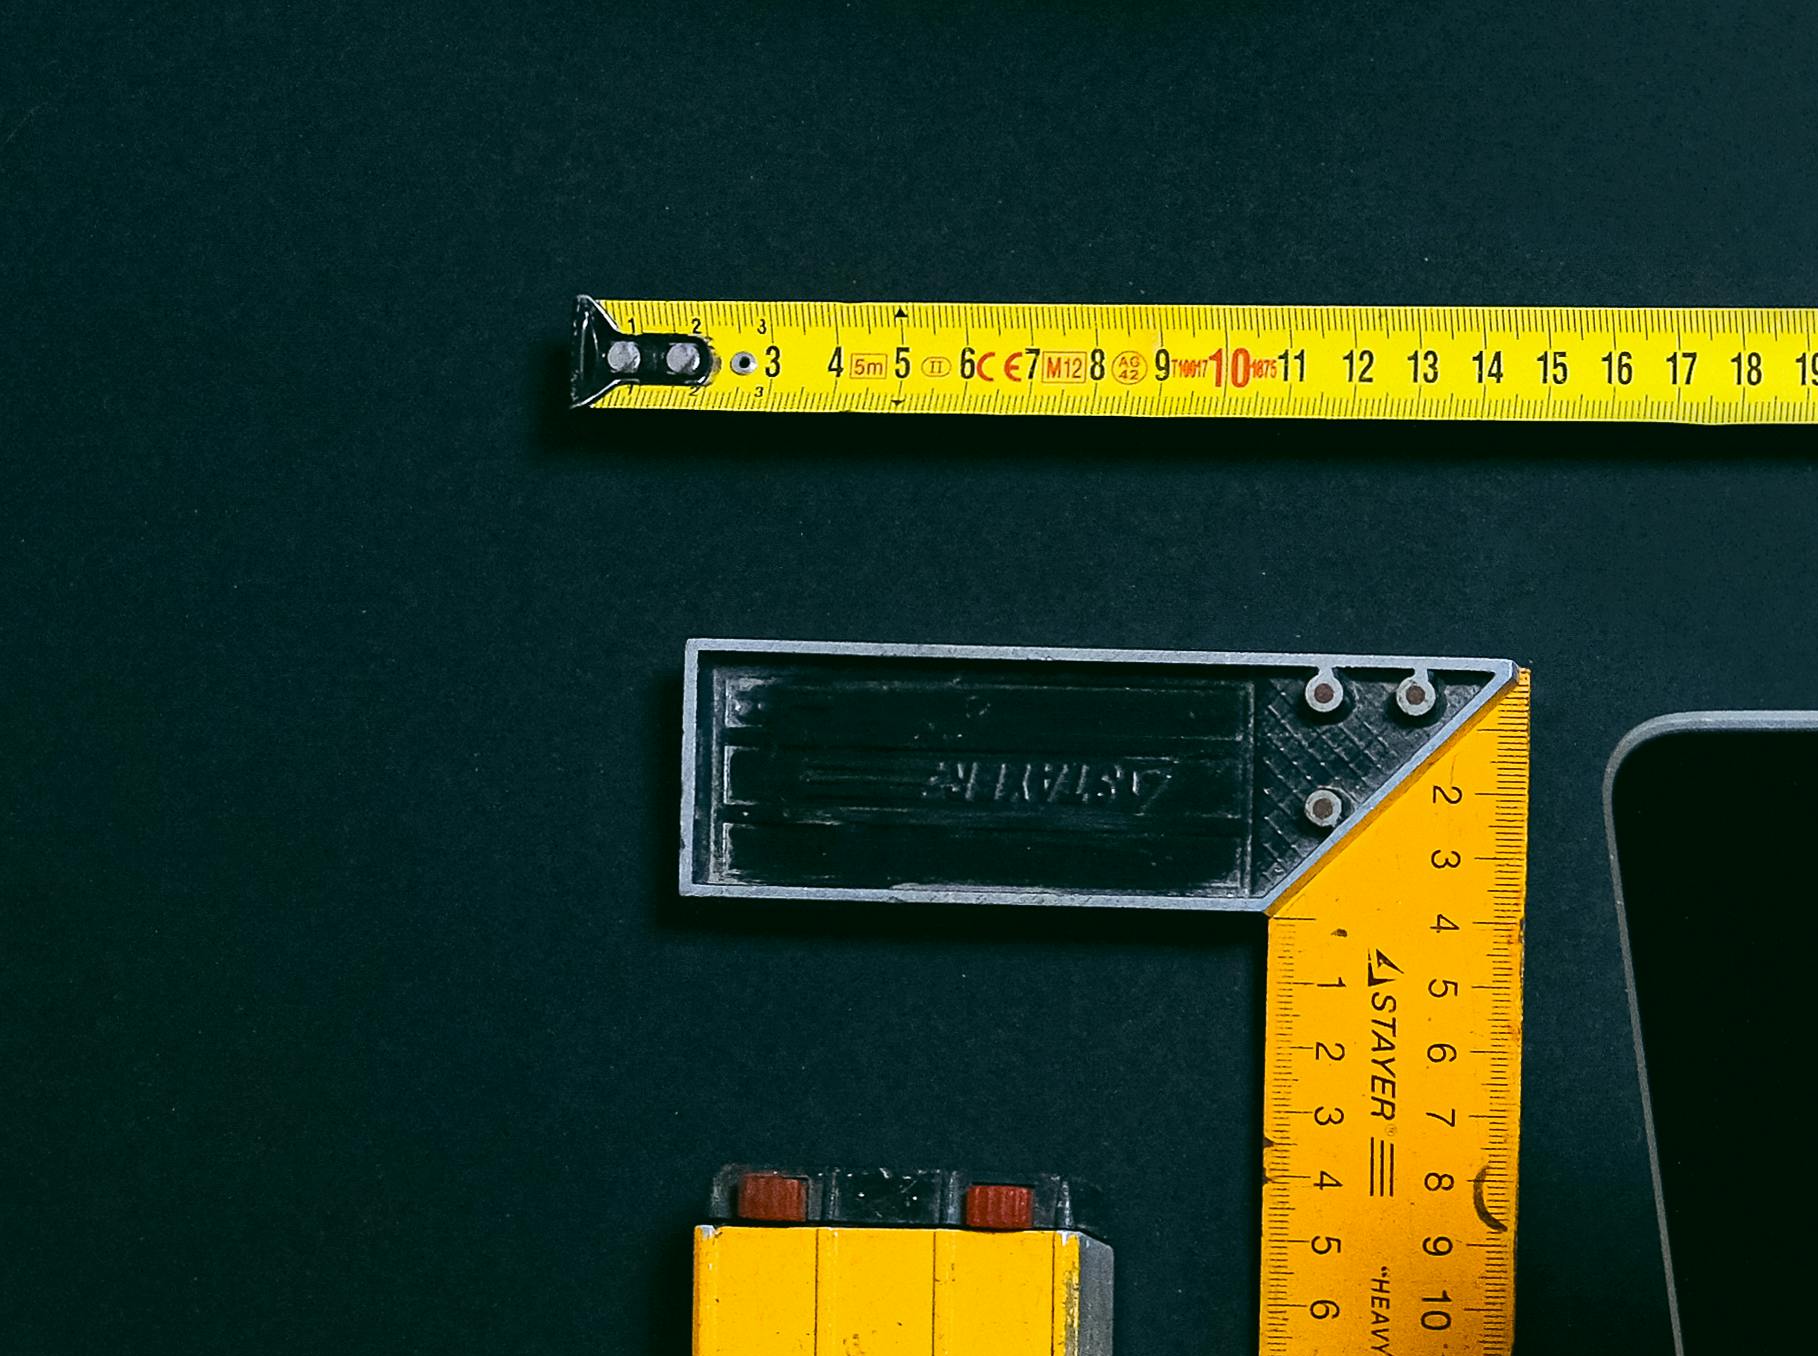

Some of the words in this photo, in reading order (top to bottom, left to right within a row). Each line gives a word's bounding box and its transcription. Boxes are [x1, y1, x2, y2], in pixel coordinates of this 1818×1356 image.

[757, 319, 767, 334] 3
[765, 345, 781, 377] 3
[828, 346, 843, 377] 4
[895, 347, 910, 379] 5
[960, 347, 976, 379] 6
[1025, 348, 1040, 379] 7
[1090, 348, 1105, 381] 8
[1155, 348, 1170, 381] 9
[1209, 348, 1250, 387] 10
[1277, 349, 1305, 382] 11
[1342, 349, 1374, 383] 12
[1407, 350, 1438, 383] 13
[1472, 350, 1503, 384] 14
[1537, 350, 1568, 384] 15
[1601, 351, 1632, 385] 16
[1730, 352, 1762, 386] 18
[854, 359, 883, 375] 5m
[1047, 357, 1082, 379] M12
[1119, 370, 1139, 380] 42
[1433, 785, 1462, 804] 2
[1431, 850, 1461, 869] 3
[1428, 979, 1458, 998] 5
[1316, 1042, 1345, 1061] 2
[1371, 992, 1396, 1121] STAYER
[1427, 1044, 1457, 1063] 6
[1314, 1106, 1344, 1125] 3
[1426, 1109, 1455, 1127] 7
[1313, 1171, 1343, 1190] 4
[1424, 1173, 1454, 1191] 8
[1311, 1236, 1341, 1255] 5
[1422, 1236, 1453, 1256] 9
[1309, 1300, 1340, 1320] 6
[1420, 1290, 1452, 1331] 10
